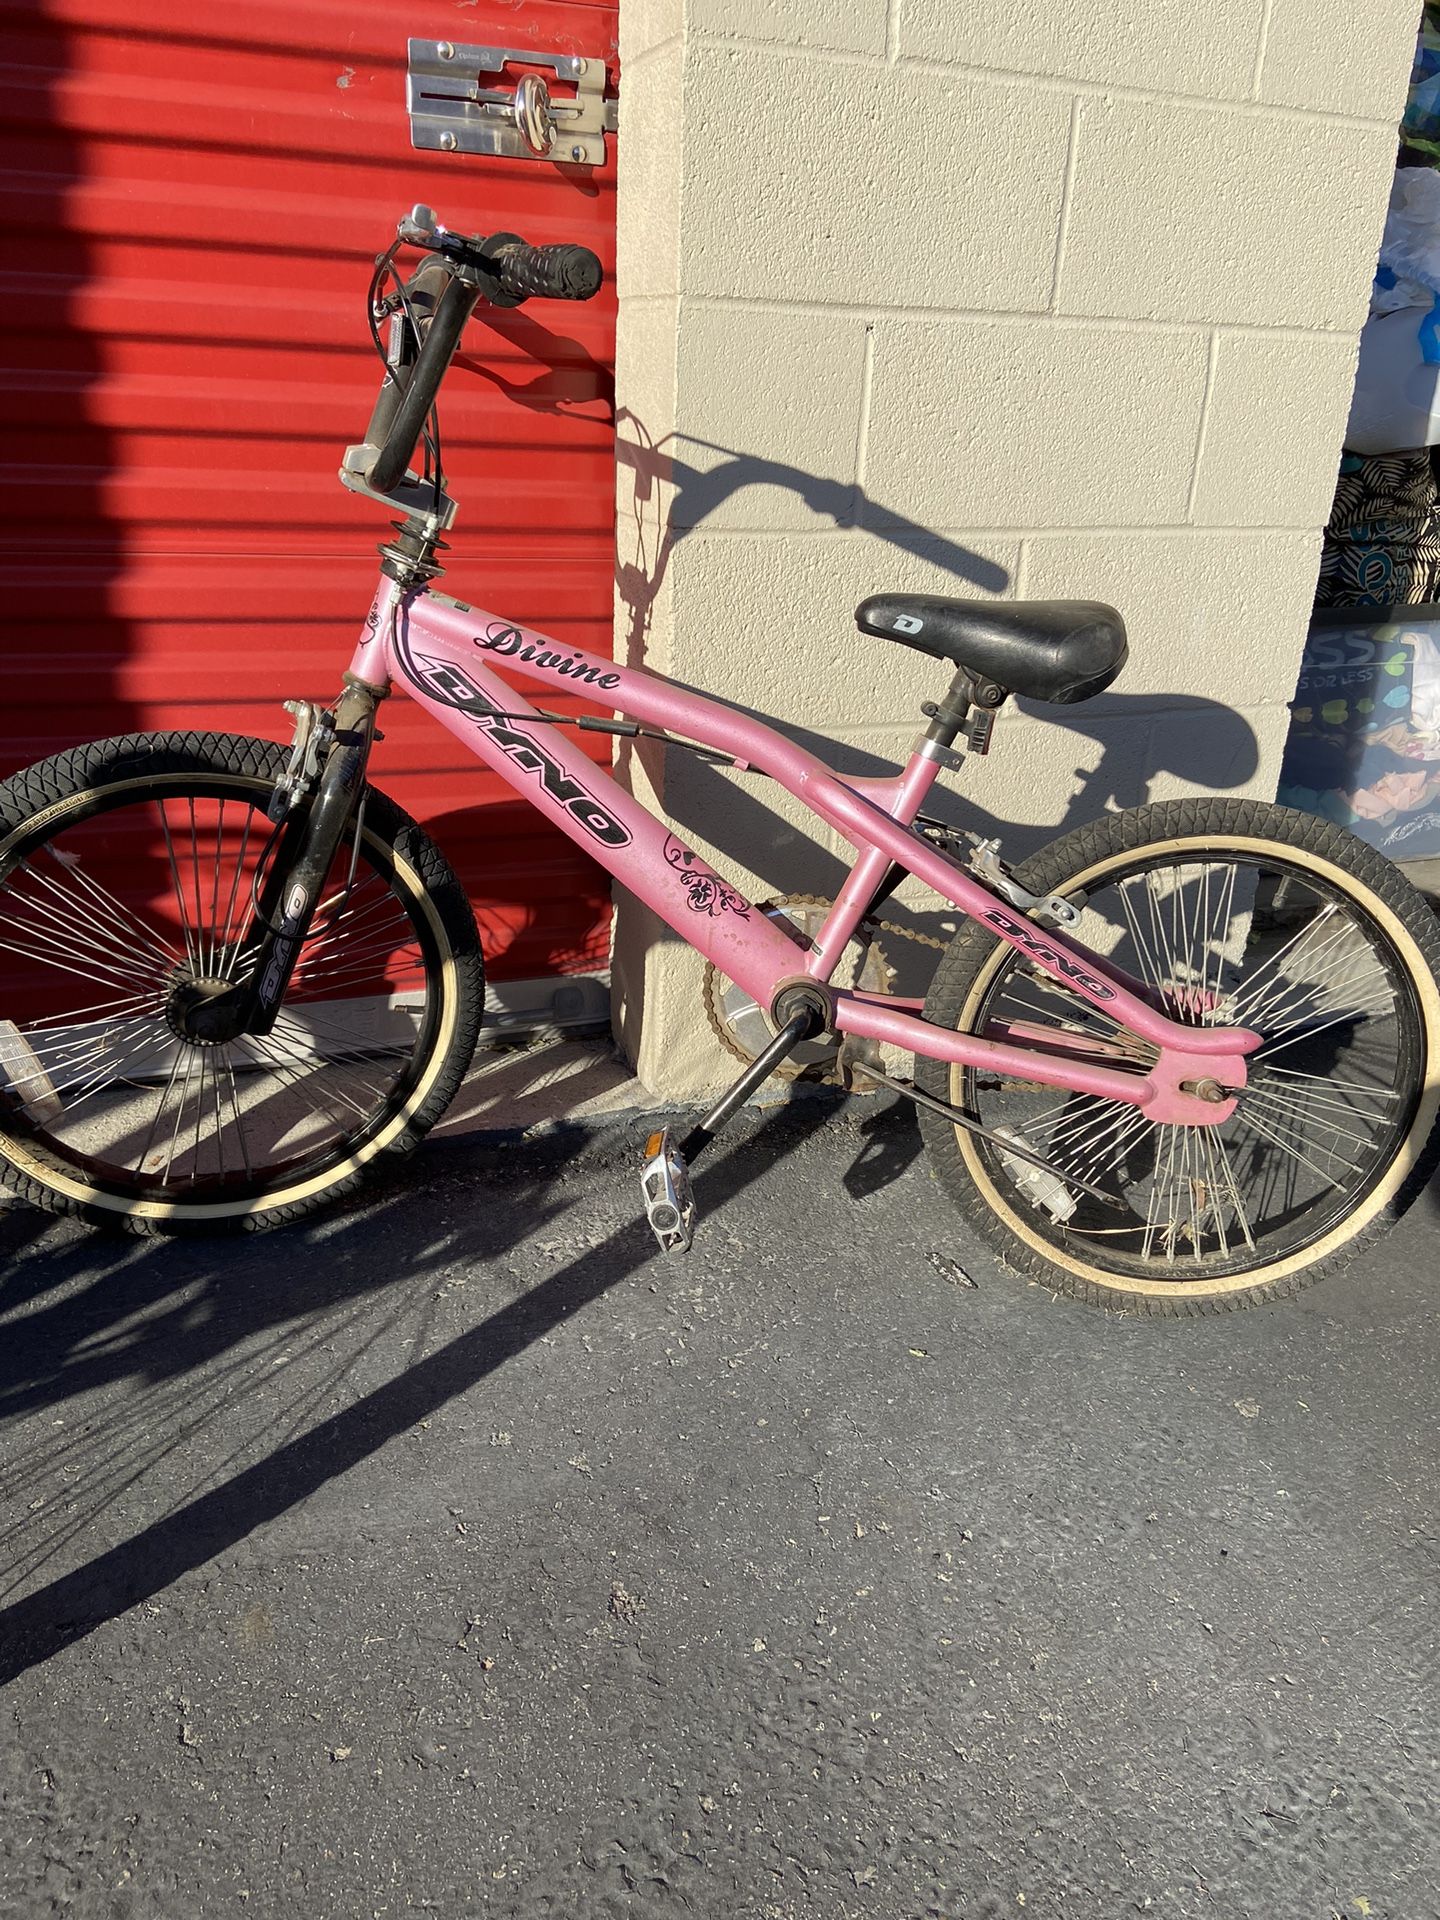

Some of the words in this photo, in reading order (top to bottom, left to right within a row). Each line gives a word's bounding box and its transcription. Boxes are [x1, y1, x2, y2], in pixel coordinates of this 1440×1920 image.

[474, 621, 623, 690] Divine
[1302, 629, 1376, 670] SS
[414, 651, 634, 849] DYNO
[979, 907, 1118, 1001] DYNO
